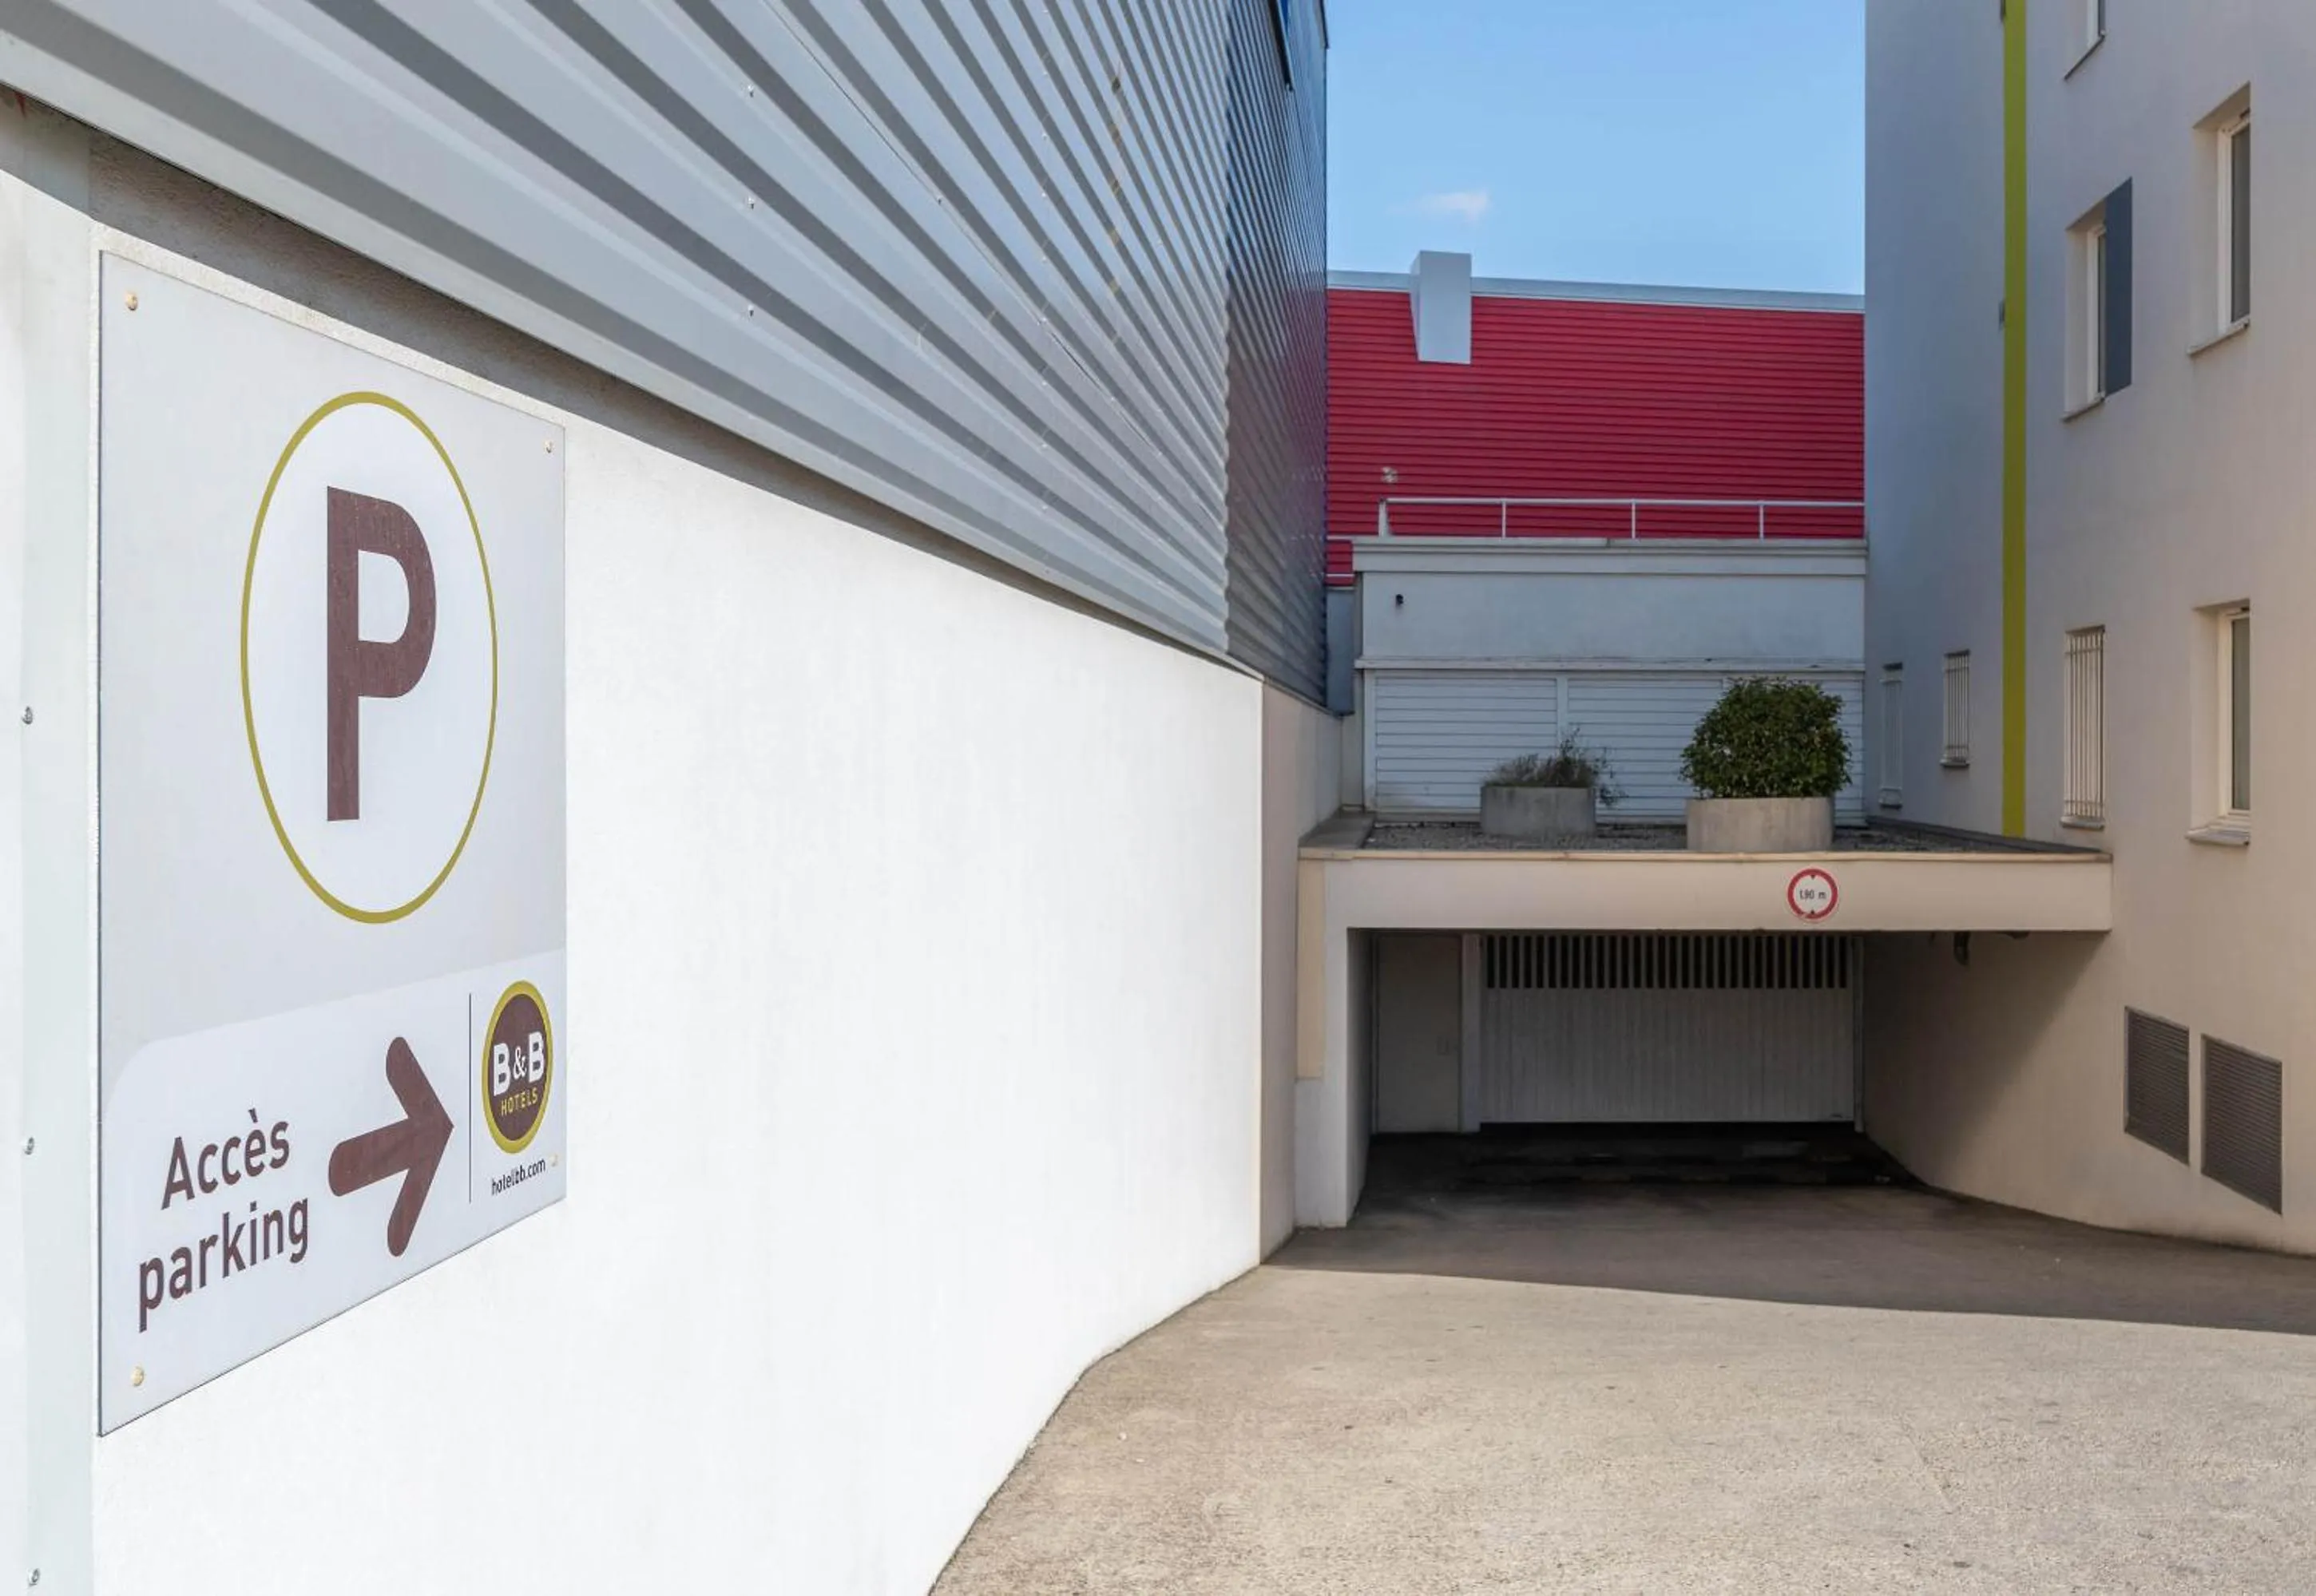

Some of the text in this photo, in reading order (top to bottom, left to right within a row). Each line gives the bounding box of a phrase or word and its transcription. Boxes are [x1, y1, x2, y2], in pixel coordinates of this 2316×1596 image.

[327, 485, 437, 822] P
[1818, 891, 1826, 900] m
[494, 1031, 545, 1096] B&B
[501, 1087, 538, 1115] HOTELS
[161, 1107, 290, 1210] Accès
[138, 1197, 309, 1333] parking
